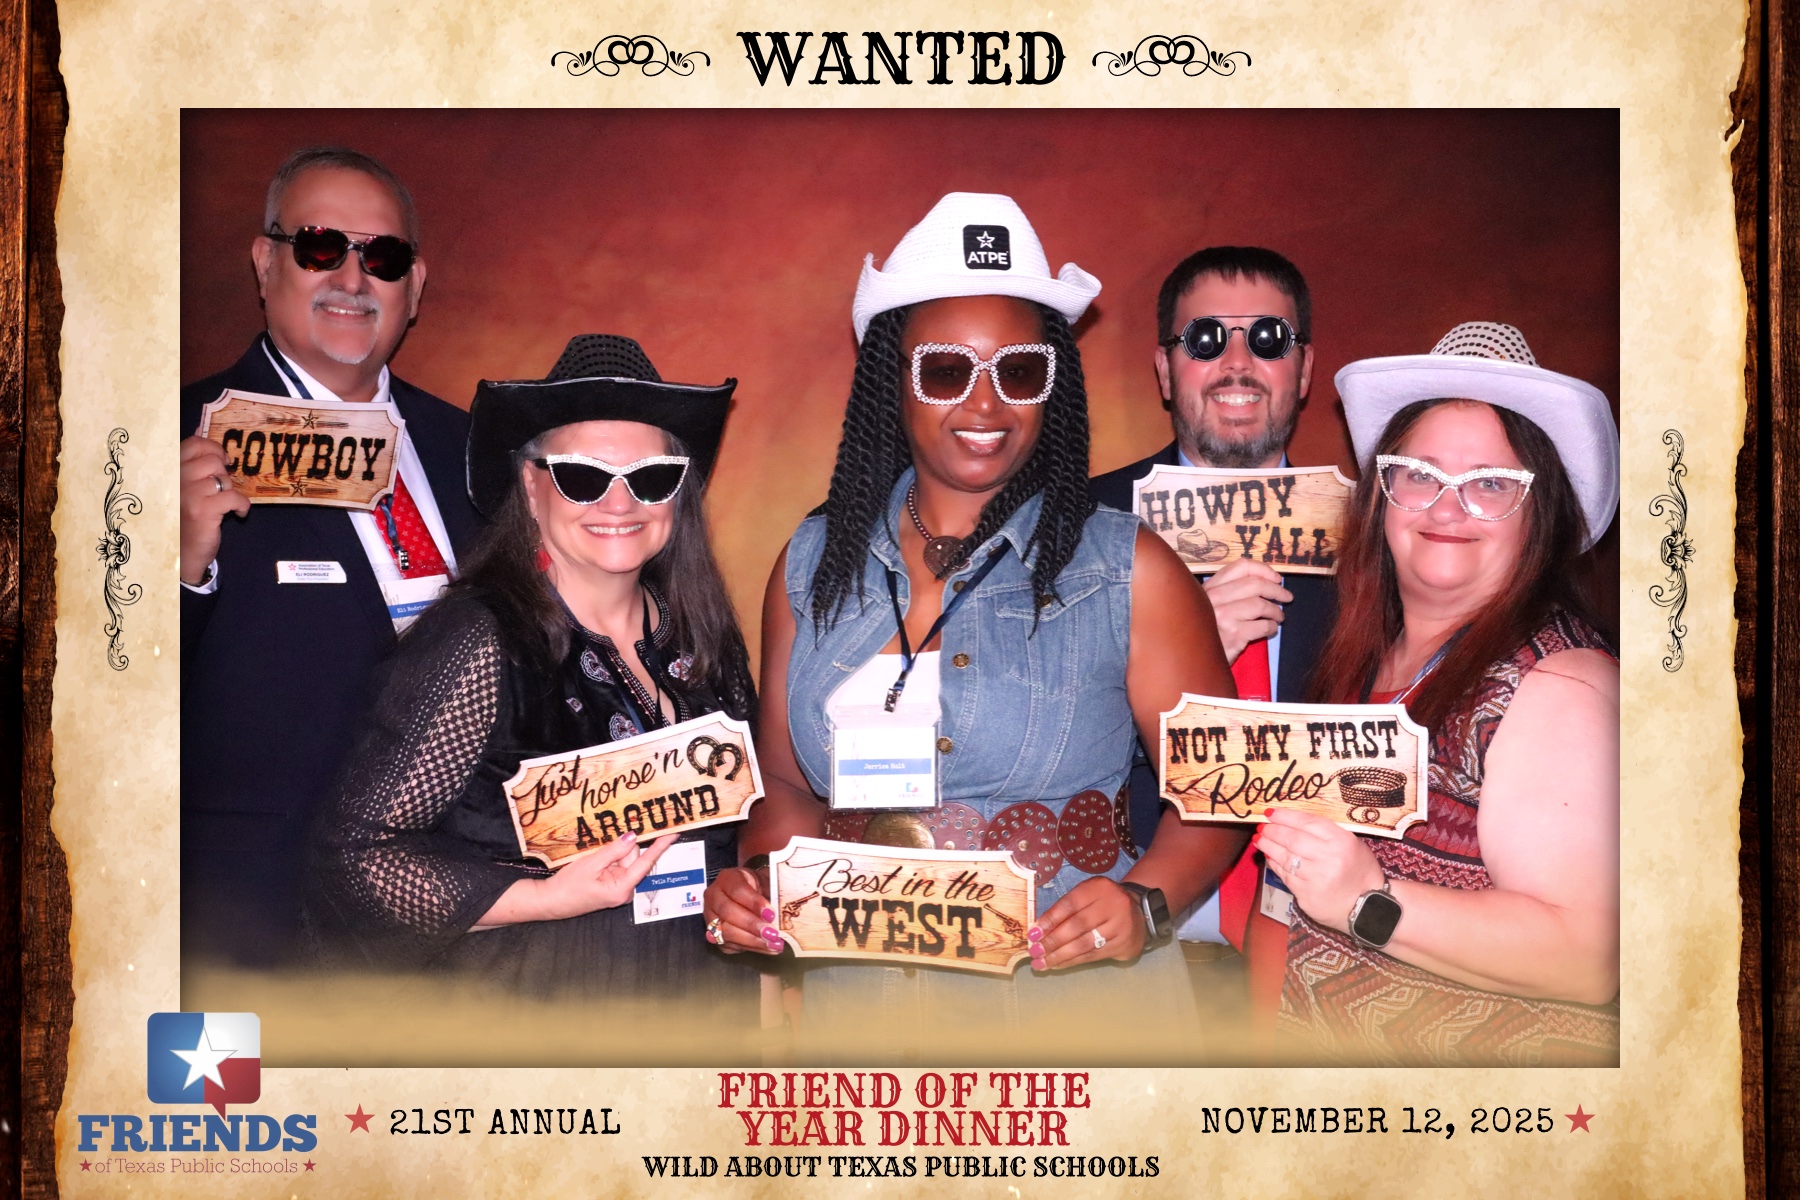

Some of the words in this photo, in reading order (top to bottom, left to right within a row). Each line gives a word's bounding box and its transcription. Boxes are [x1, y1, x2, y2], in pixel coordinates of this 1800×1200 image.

[966, 251, 1009, 265] ATPE
[222, 428, 387, 481] COWBOY
[1141, 475, 1296, 532] HOWDY
[1235, 523, 1335, 567] Y'ALL
[1168, 725, 1227, 764] NOT
[1242, 724, 1291, 761] MY
[1306, 720, 1398, 760] FIRST
[511, 754, 584, 828] Just
[580, 747, 684, 813] horse'n
[1171, 759, 1331, 819] Rodeo
[575, 784, 720, 850] AROUND
[785, 858, 893, 894] Best
[901, 872, 937, 898] in
[943, 870, 995, 902] the
[821, 895, 982, 958] WEST
